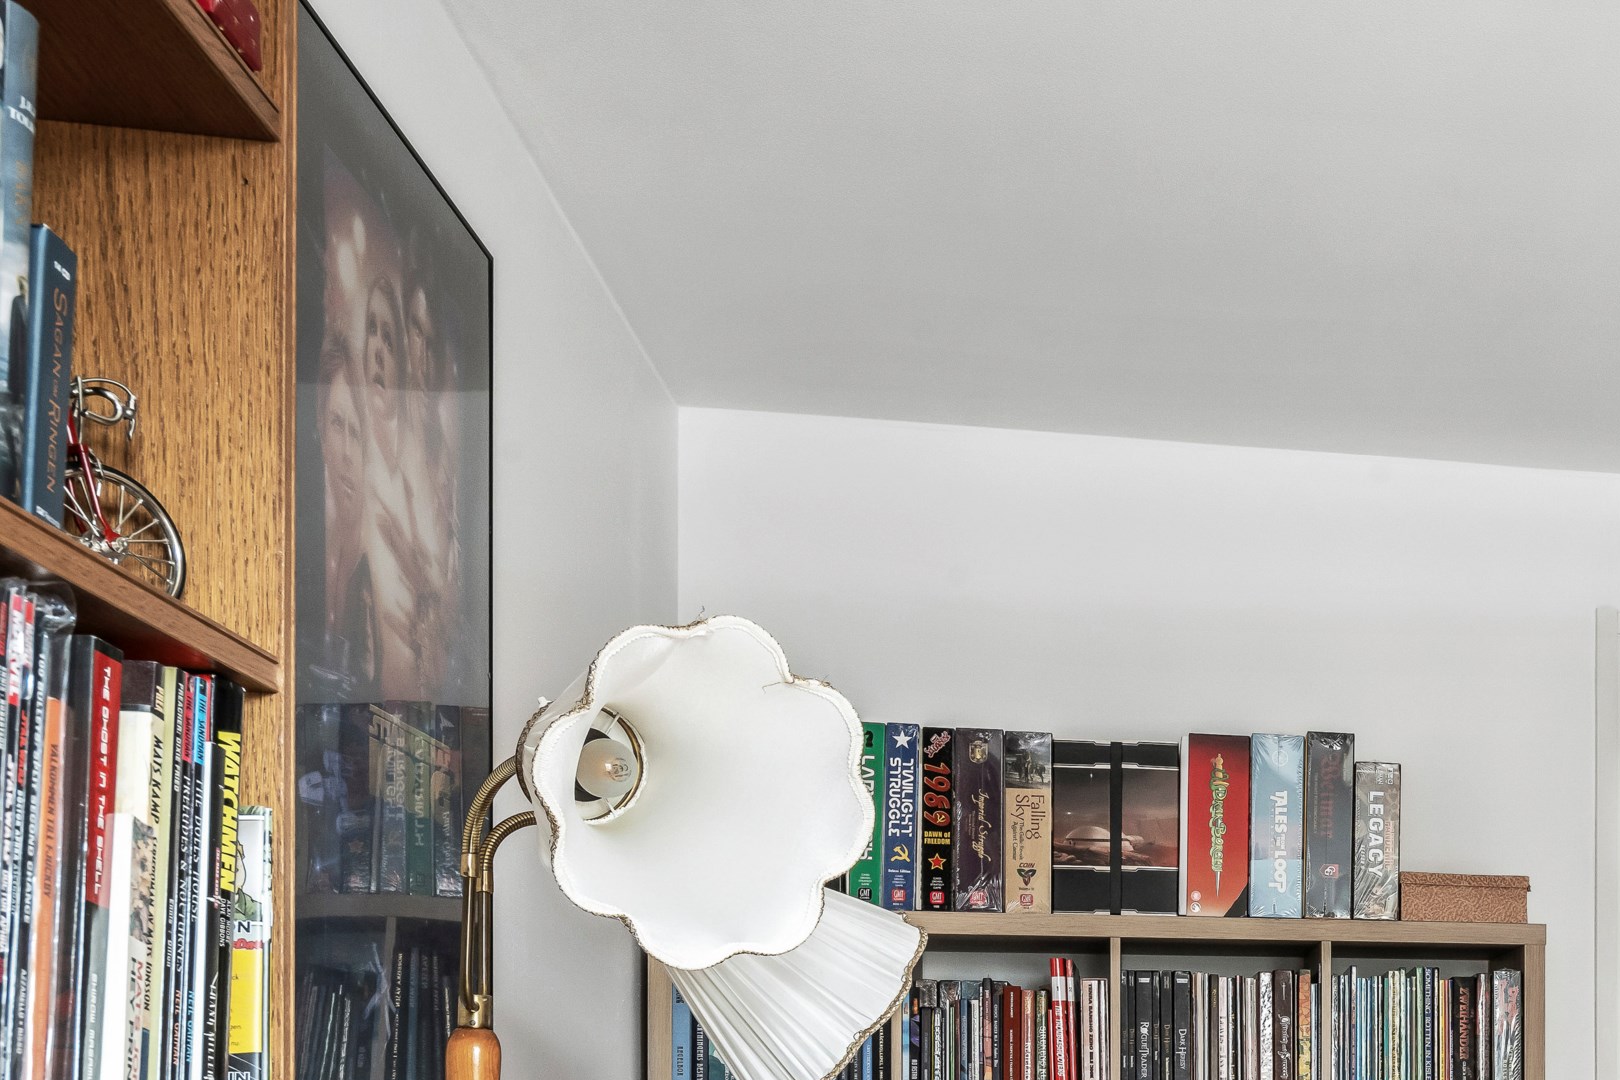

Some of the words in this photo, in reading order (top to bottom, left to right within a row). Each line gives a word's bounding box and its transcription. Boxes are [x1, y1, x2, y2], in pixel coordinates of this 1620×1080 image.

[47, 398, 62, 492] RINGEN
[103, 667, 111, 701] THE
[100, 705, 110, 767] GHOST
[152, 734, 164, 776] MATS
[98, 771, 107, 788] IN
[149, 778, 163, 825] KAMP
[889, 757, 902, 837] STRUGGLE
[901, 758, 914, 838] TWILIGHT
[923, 762, 951, 827] 1989
[97, 795, 106, 826] THE
[217, 731, 241, 893] WATCHMEN
[1010, 794, 1031, 821] Sky
[1025, 794, 1046, 840] Falling
[1270, 791, 1288, 834] TALES
[1368, 791, 1385, 877] LEGACY
[94, 832, 104, 895] SHELL
[89, 972, 98, 1024] SHIROW
[129, 957, 138, 1012] HEY
[171, 1021, 180, 1067] GAIMAN
[185, 1021, 193, 1063] GAIMAN
